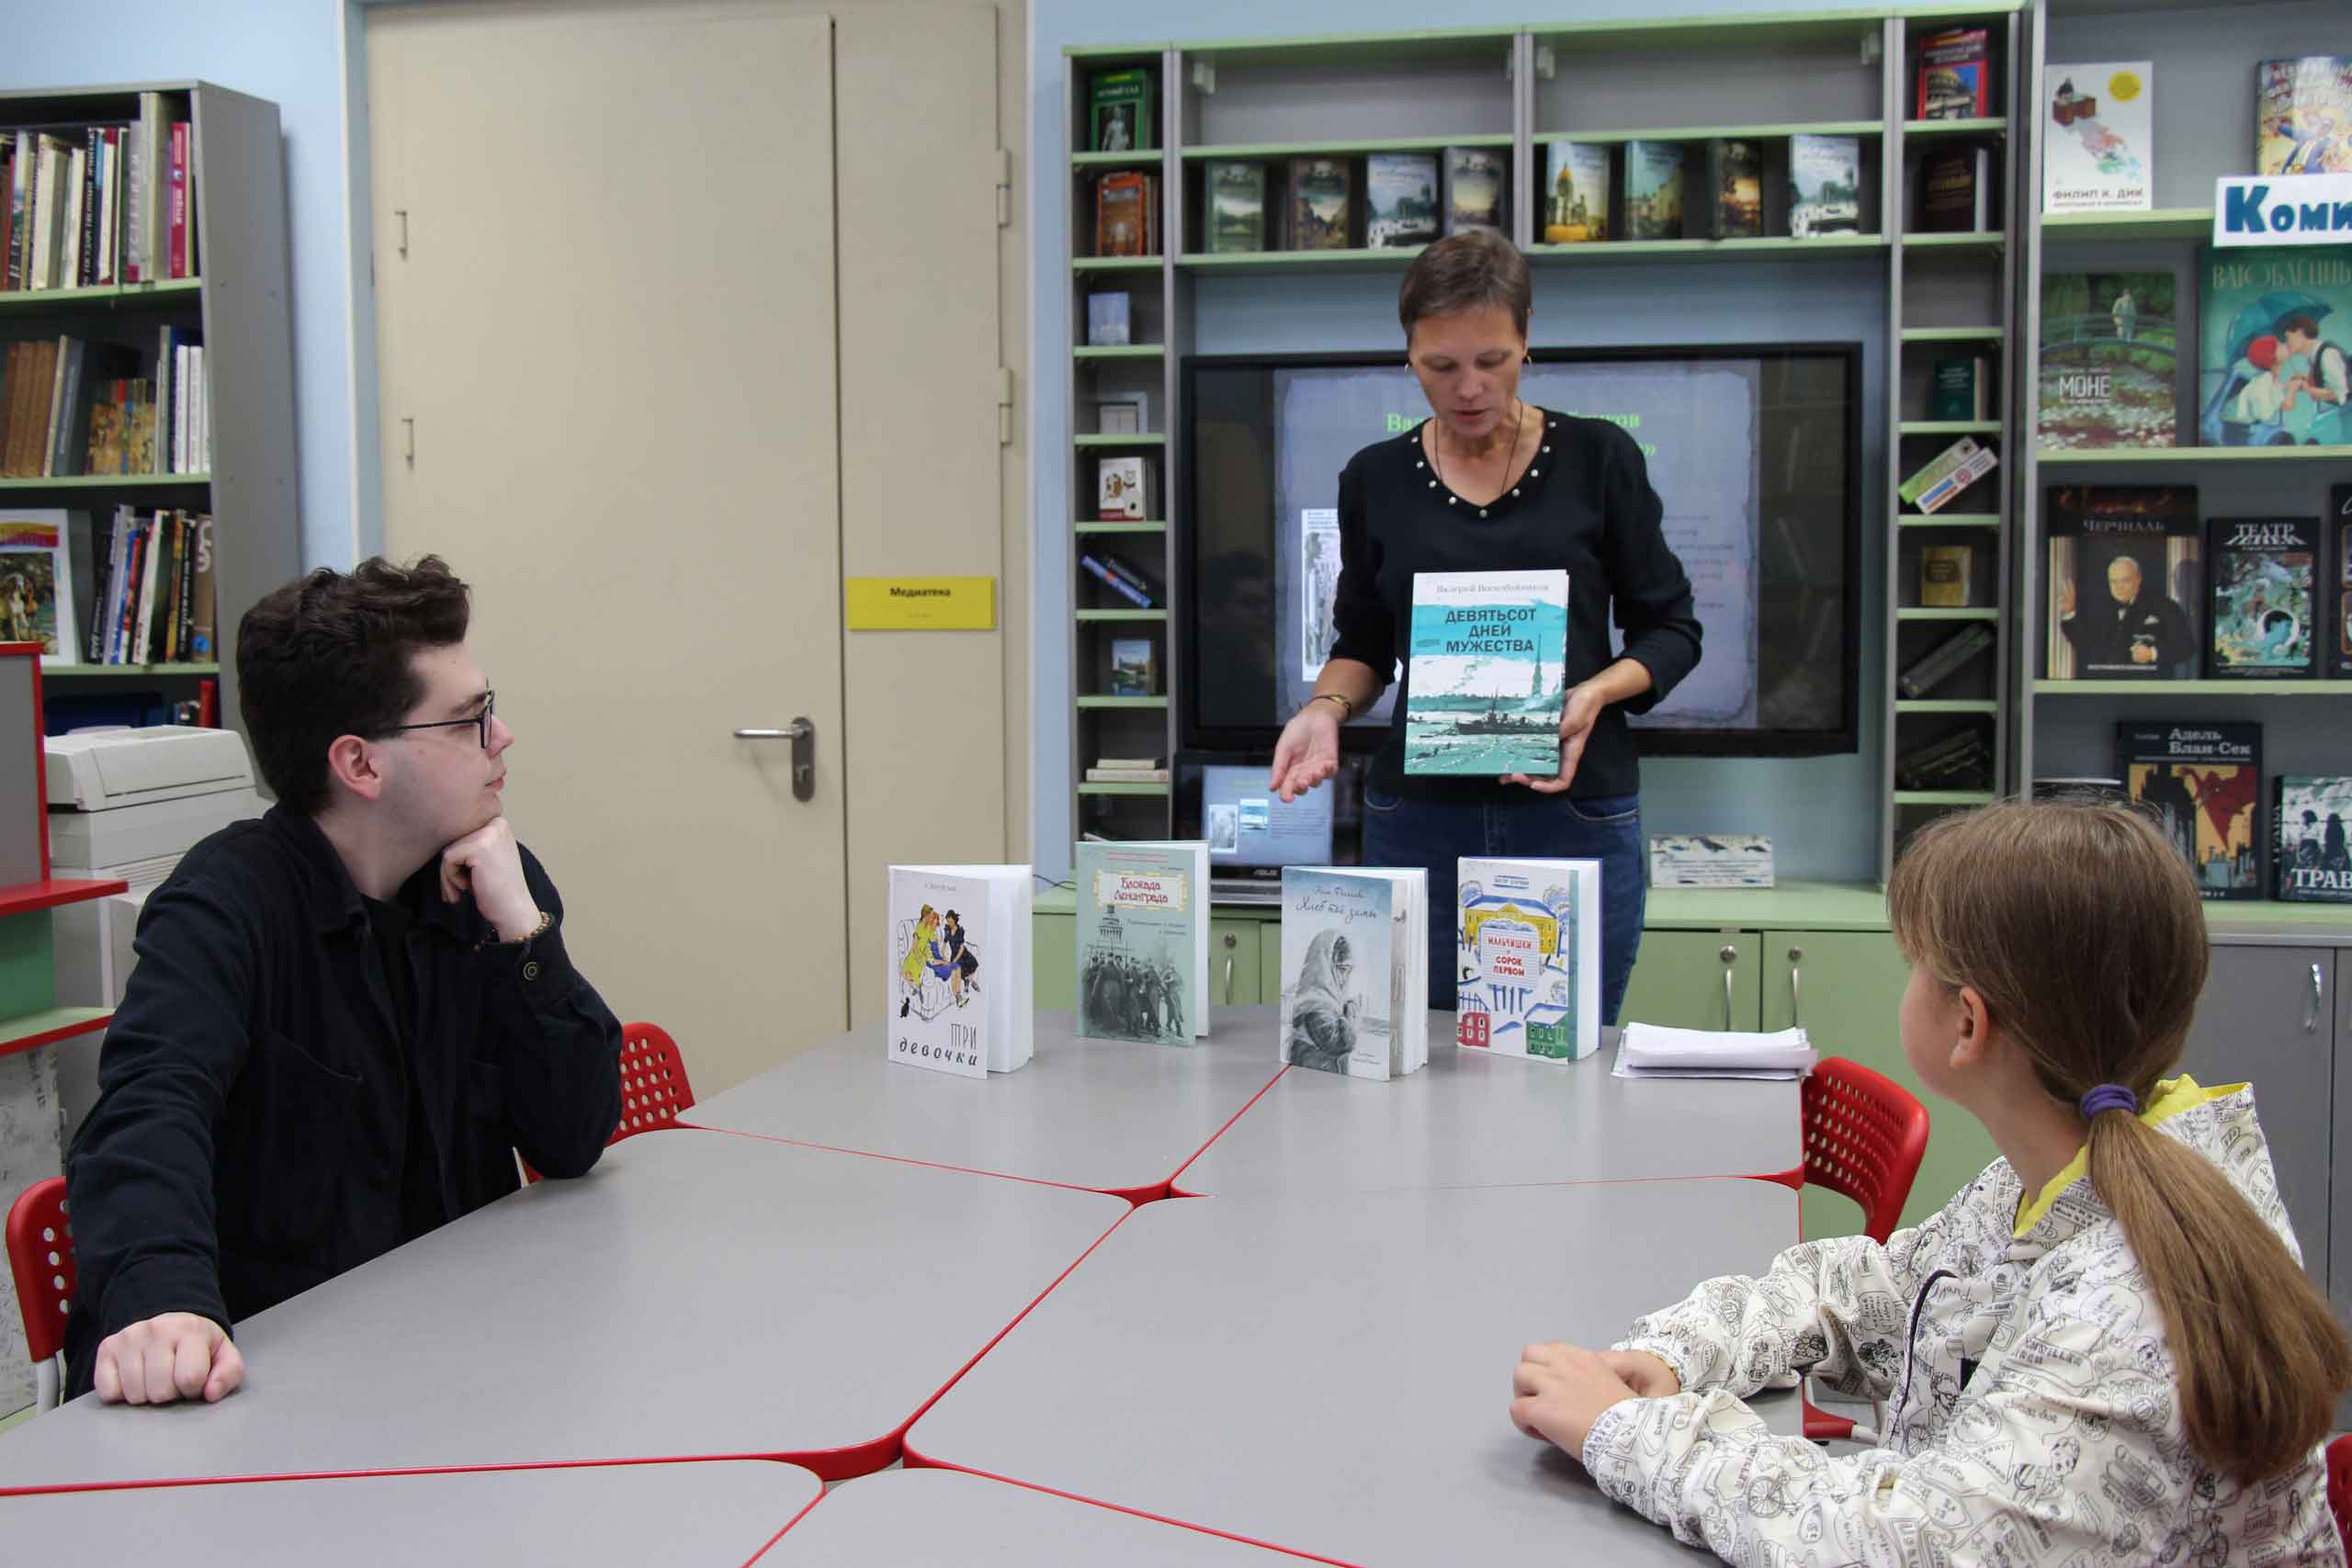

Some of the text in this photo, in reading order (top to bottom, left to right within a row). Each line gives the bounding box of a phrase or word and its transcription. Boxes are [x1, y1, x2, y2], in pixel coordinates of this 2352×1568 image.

[2059, 375, 2110, 398] МОНЕ
[889, 586, 951, 598] Медиатека
[1445, 608, 1536, 625] ДЕВЯТЬСОТ
[1468, 622, 1511, 639] ДНЕЙ
[1446, 639, 1534, 653] МУЖЕСТВА
[1496, 955, 1522, 966] СОРОК
[899, 1036, 978, 1066] девочки
